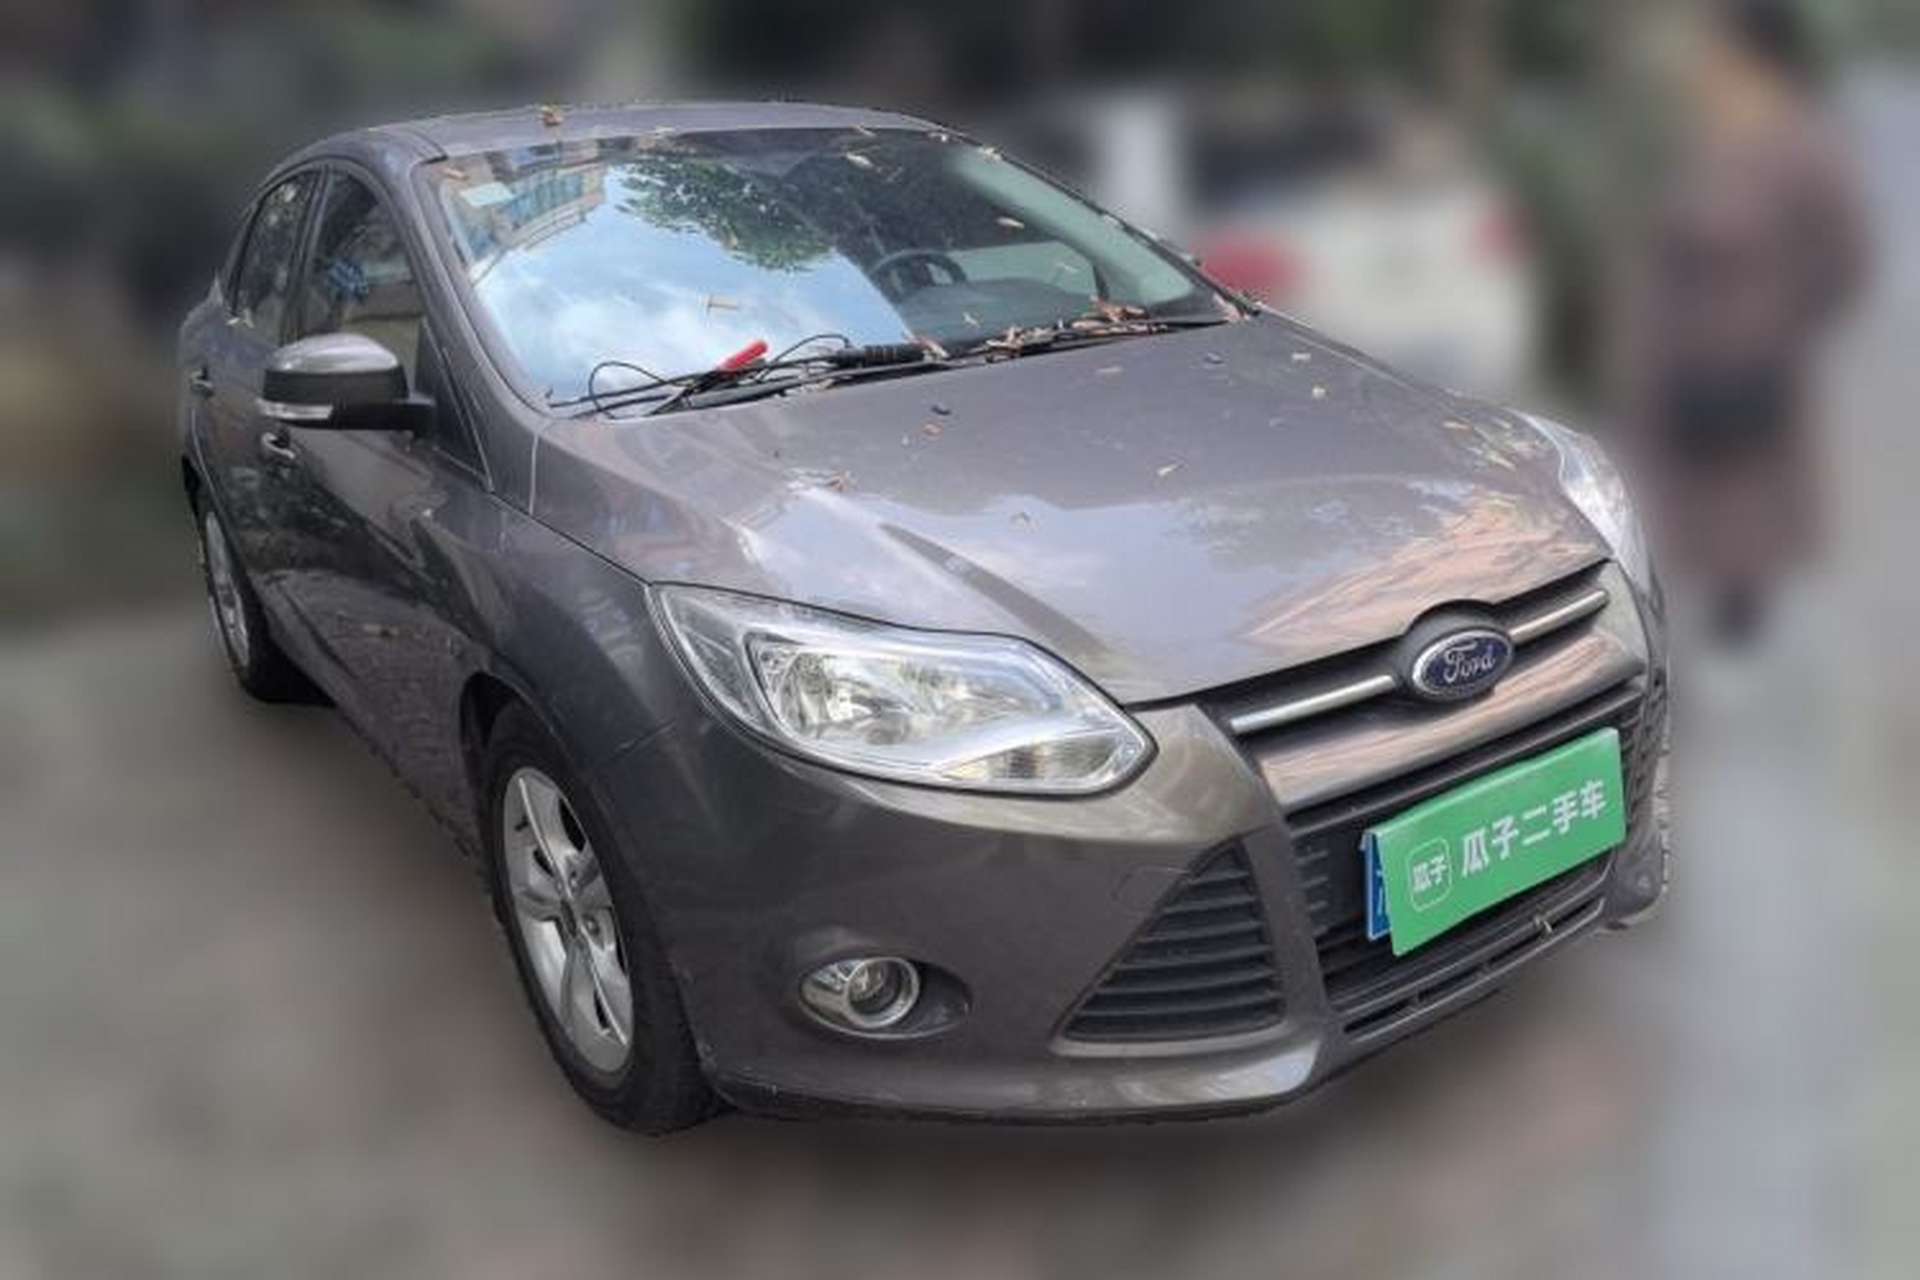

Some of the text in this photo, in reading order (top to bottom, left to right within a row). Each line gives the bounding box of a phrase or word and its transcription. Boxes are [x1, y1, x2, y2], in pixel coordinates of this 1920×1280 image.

[1443, 640, 1496, 683] Ford
[1461, 779, 1606, 877] 瓜子二手车
[1412, 854, 1448, 893] 瓜子
